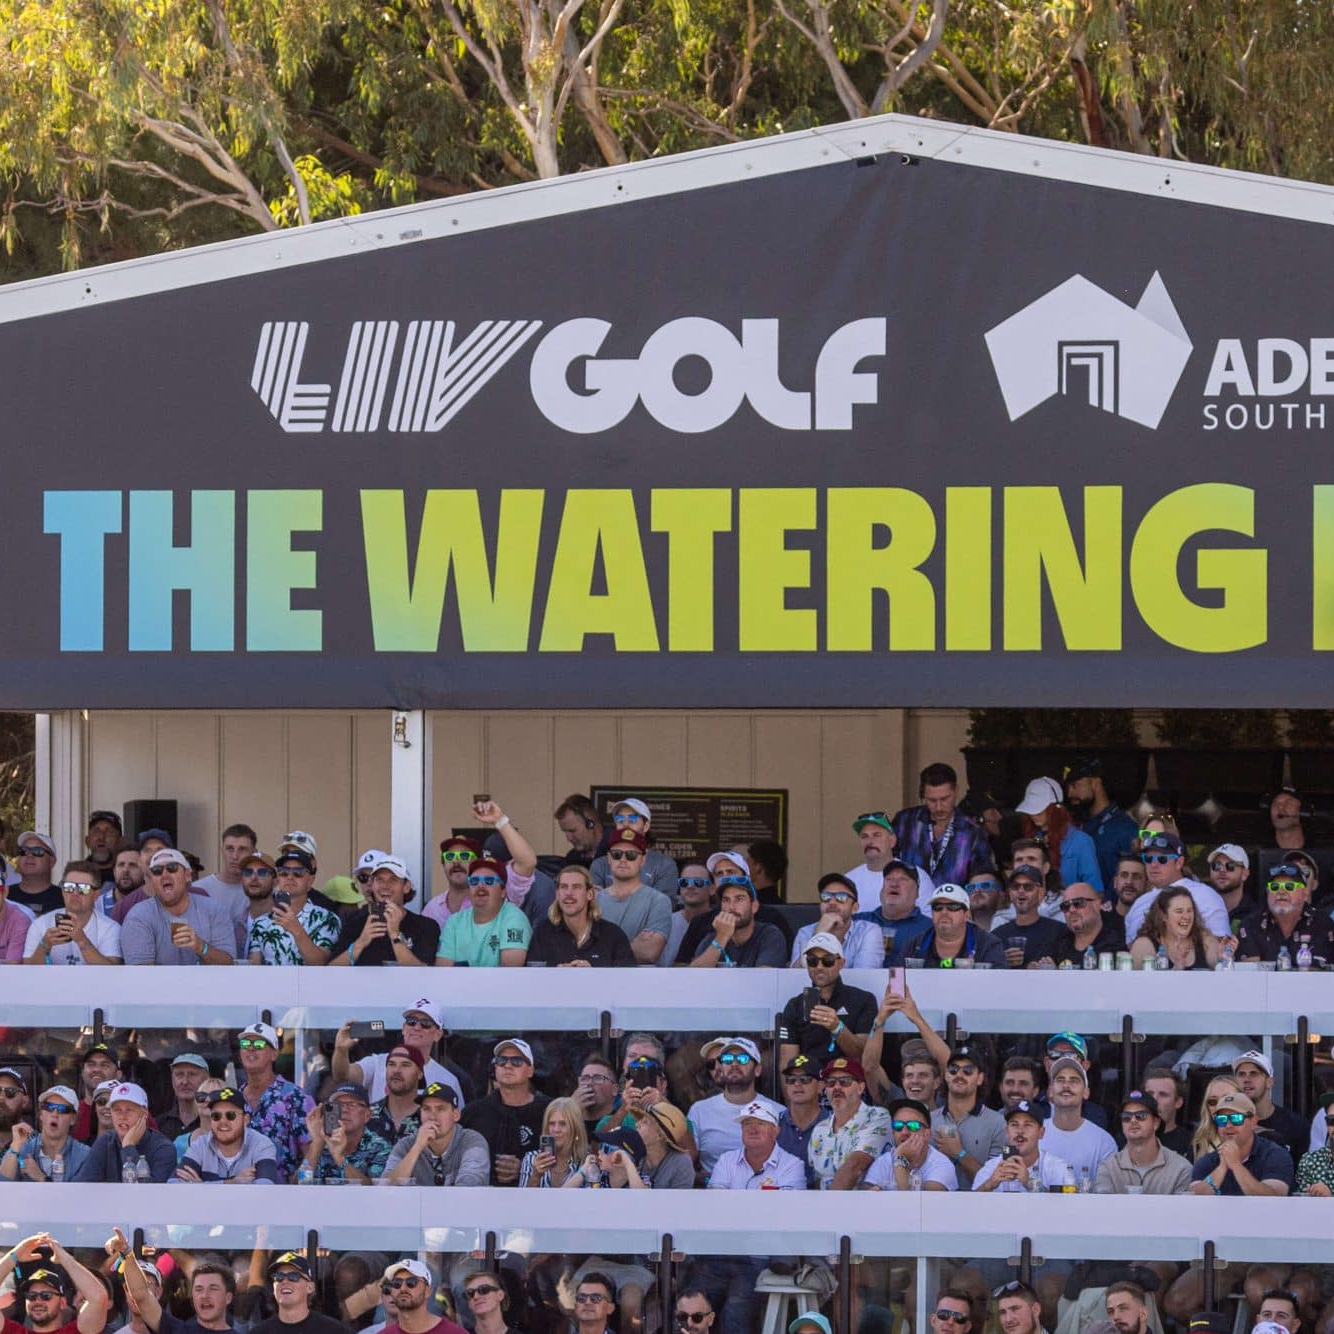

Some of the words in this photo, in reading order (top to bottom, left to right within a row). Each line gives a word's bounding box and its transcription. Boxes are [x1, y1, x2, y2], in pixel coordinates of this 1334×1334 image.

[251, 320, 543, 433] LIV
[530, 316, 887, 434] GOLF
[1202, 403, 1325, 430] SOUTH
[43, 489, 321, 652] THE
[360, 483, 1269, 653] WATERING
